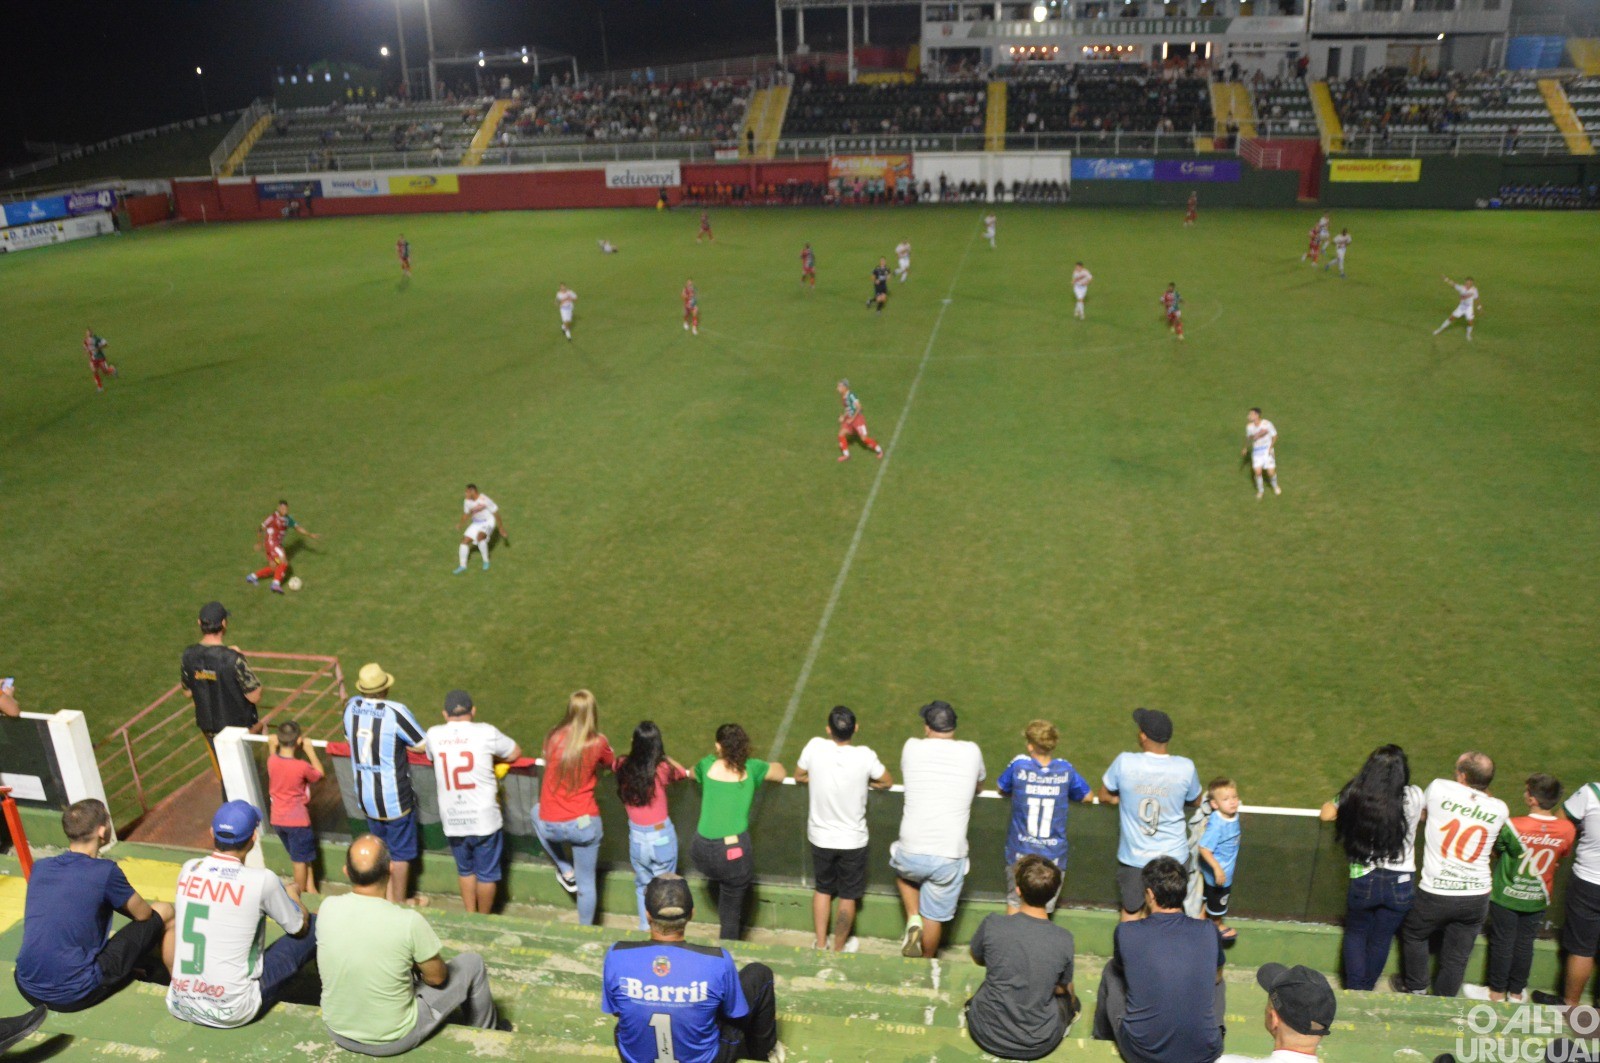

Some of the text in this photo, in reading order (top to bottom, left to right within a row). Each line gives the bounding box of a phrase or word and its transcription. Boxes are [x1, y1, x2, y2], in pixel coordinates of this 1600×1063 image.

[351, 704, 386, 719] Banrisul
[356, 728, 373, 764] 7
[439, 751, 476, 791] 12
[1027, 771, 1069, 784] Banrisul
[1027, 797, 1055, 838] 11
[1139, 798, 1160, 836] 9
[1441, 799, 1498, 824] creluz
[1440, 818, 1488, 863] 10
[1519, 834, 1563, 847] creluz
[1518, 847, 1555, 877] 10
[180, 902, 210, 975] 5
[626, 977, 708, 1003] Barril
[648, 1013, 680, 1063] 1
